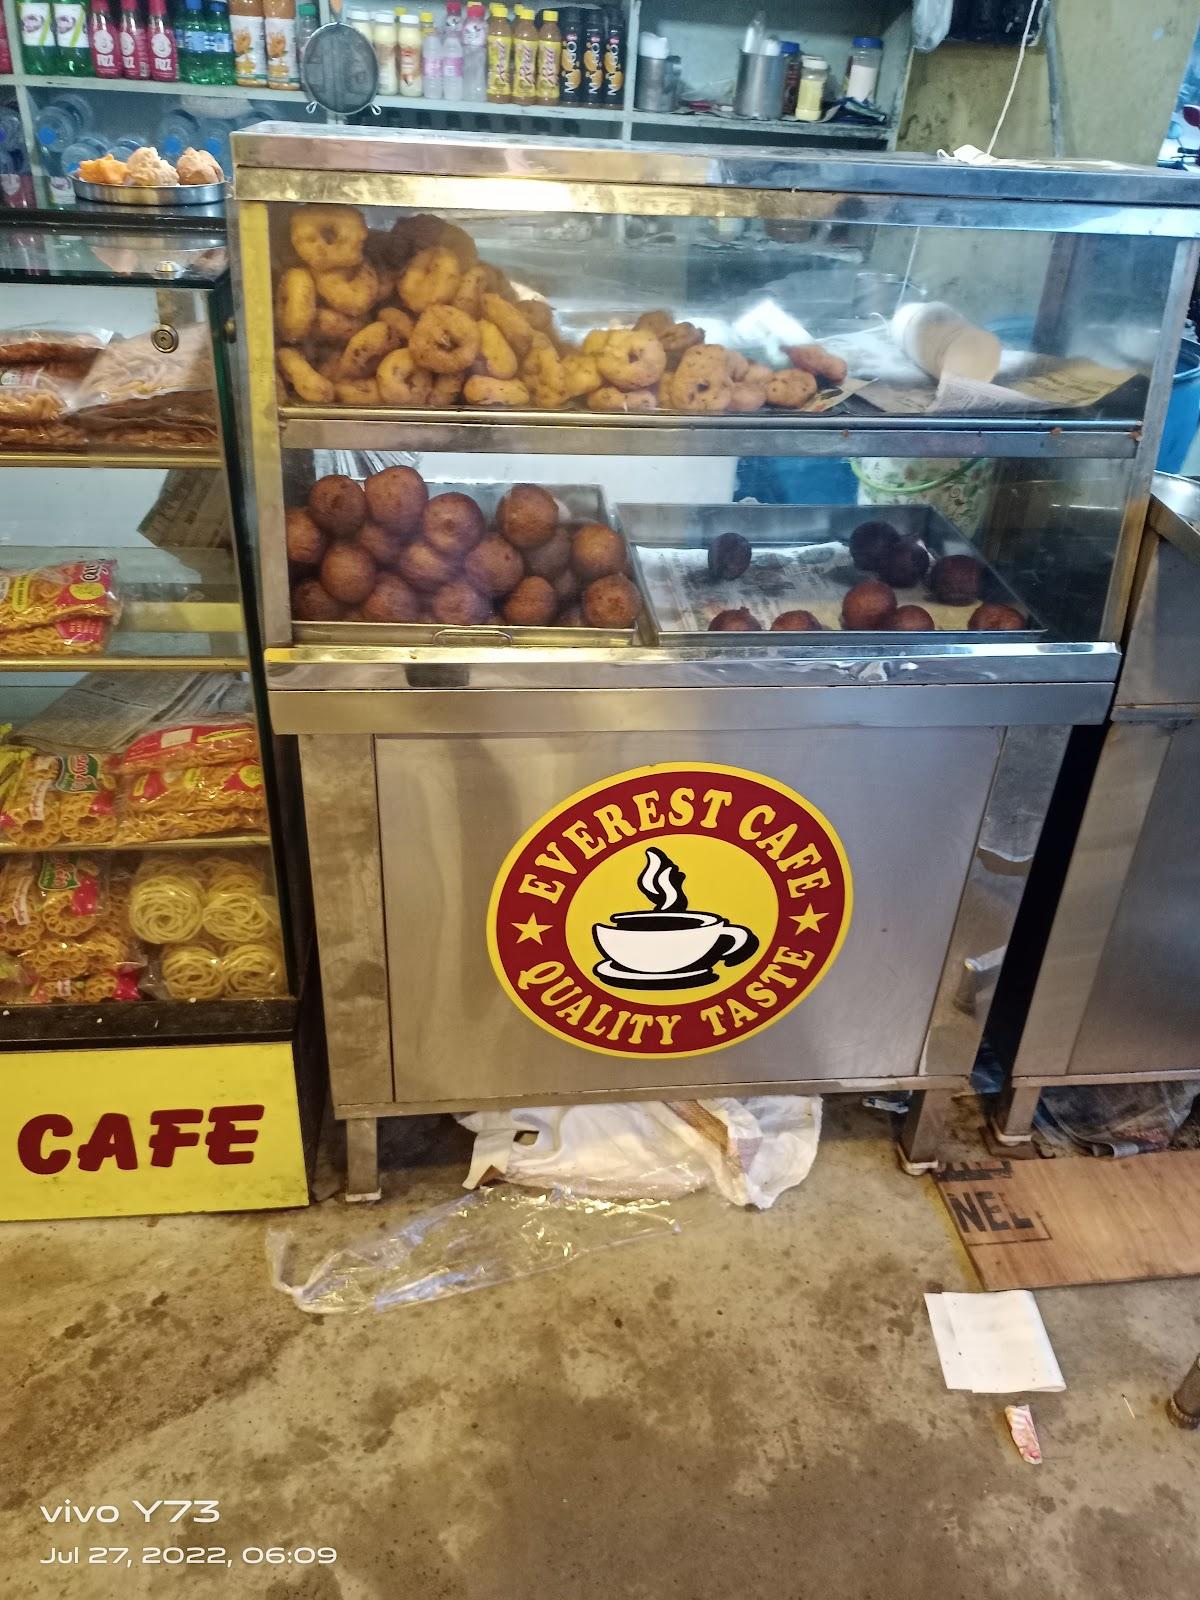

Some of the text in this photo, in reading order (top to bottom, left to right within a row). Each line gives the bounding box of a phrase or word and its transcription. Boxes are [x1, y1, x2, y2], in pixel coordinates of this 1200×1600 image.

[518, 788, 832, 904] EVEREST CAFE
[517, 946, 816, 1045] QUALITY TASTE
[17, 1104, 265, 1175] CAFE
